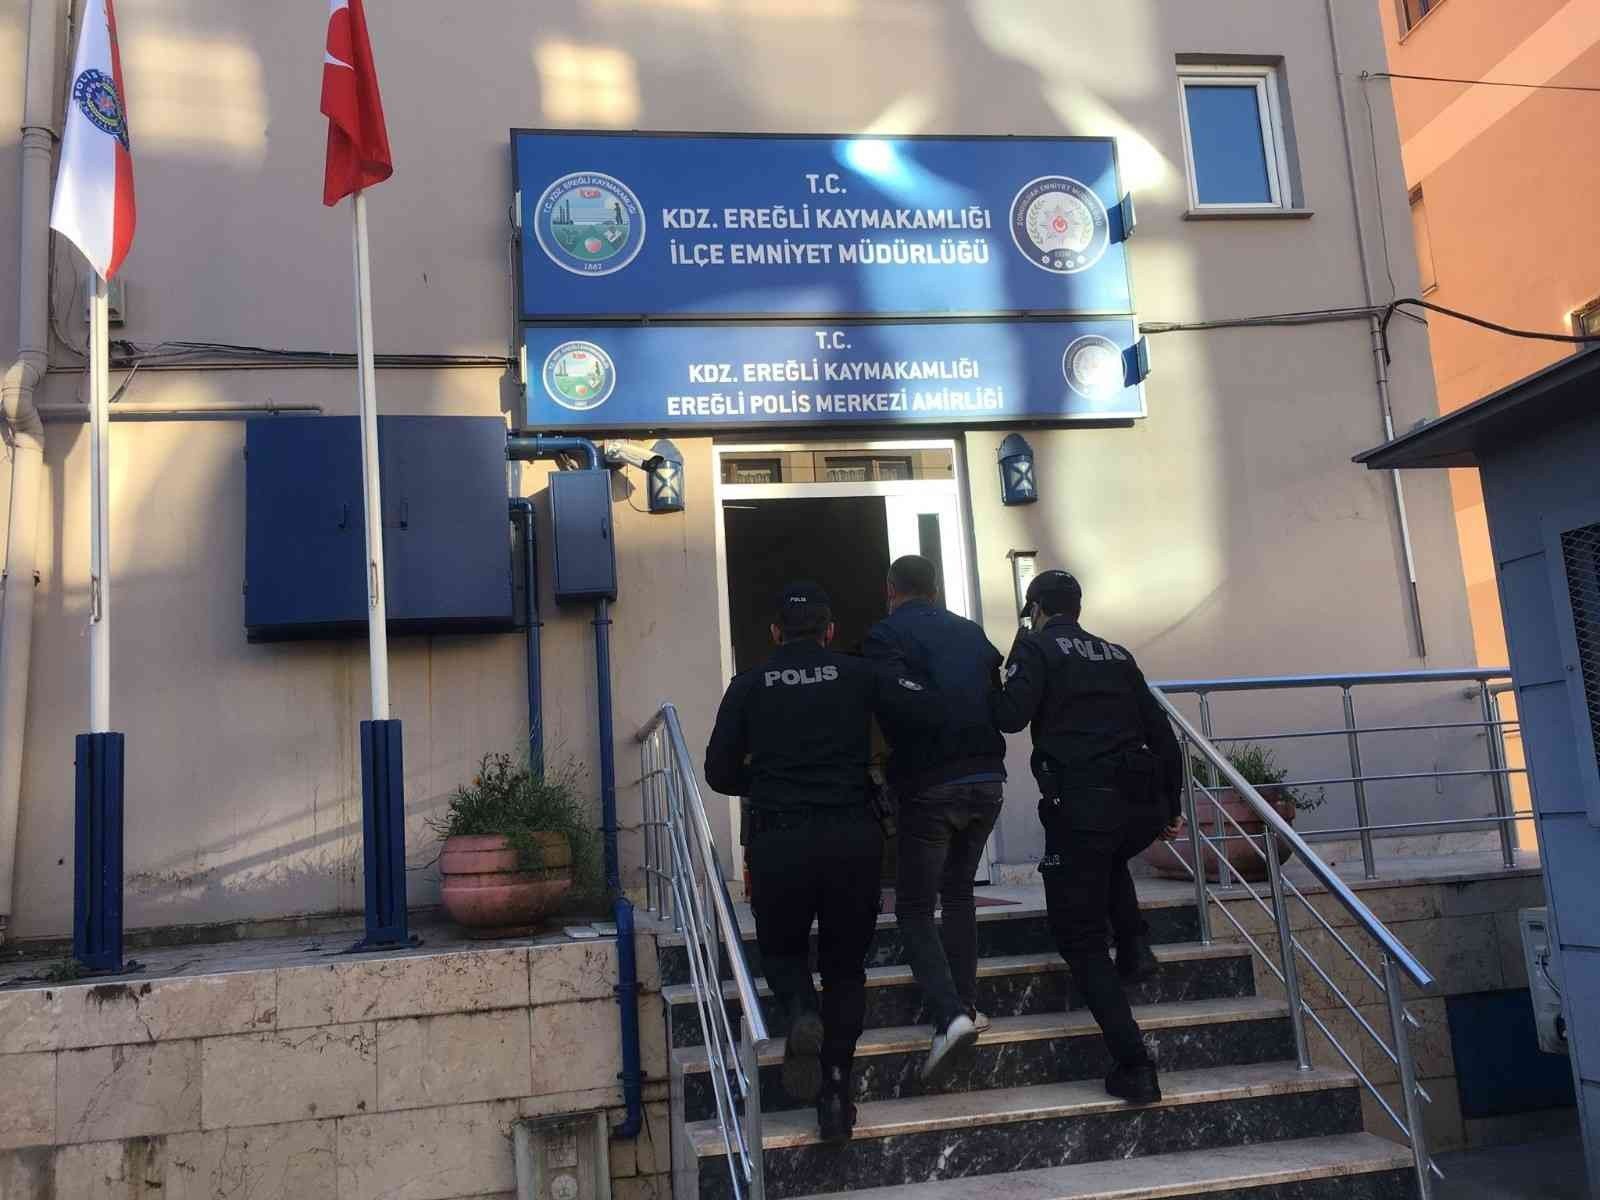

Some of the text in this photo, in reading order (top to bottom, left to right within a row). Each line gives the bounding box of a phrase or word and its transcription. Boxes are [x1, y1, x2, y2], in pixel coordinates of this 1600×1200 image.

[805, 173, 847, 194] T.C.
[662, 203, 992, 230] KDZ. EREĞLİ KAYMAKAMLIĞI
[669, 238, 990, 267] İLÇE EMNİYET MÜDÜRLÜĞÜ
[815, 331, 852, 350] T.C.
[688, 357, 980, 384] KDZ. EREĞLİ KAYMAKAMLIĞI
[667, 385, 1004, 416] EREĞLİ POLİS MERKEZİ AMİRLİĞİ
